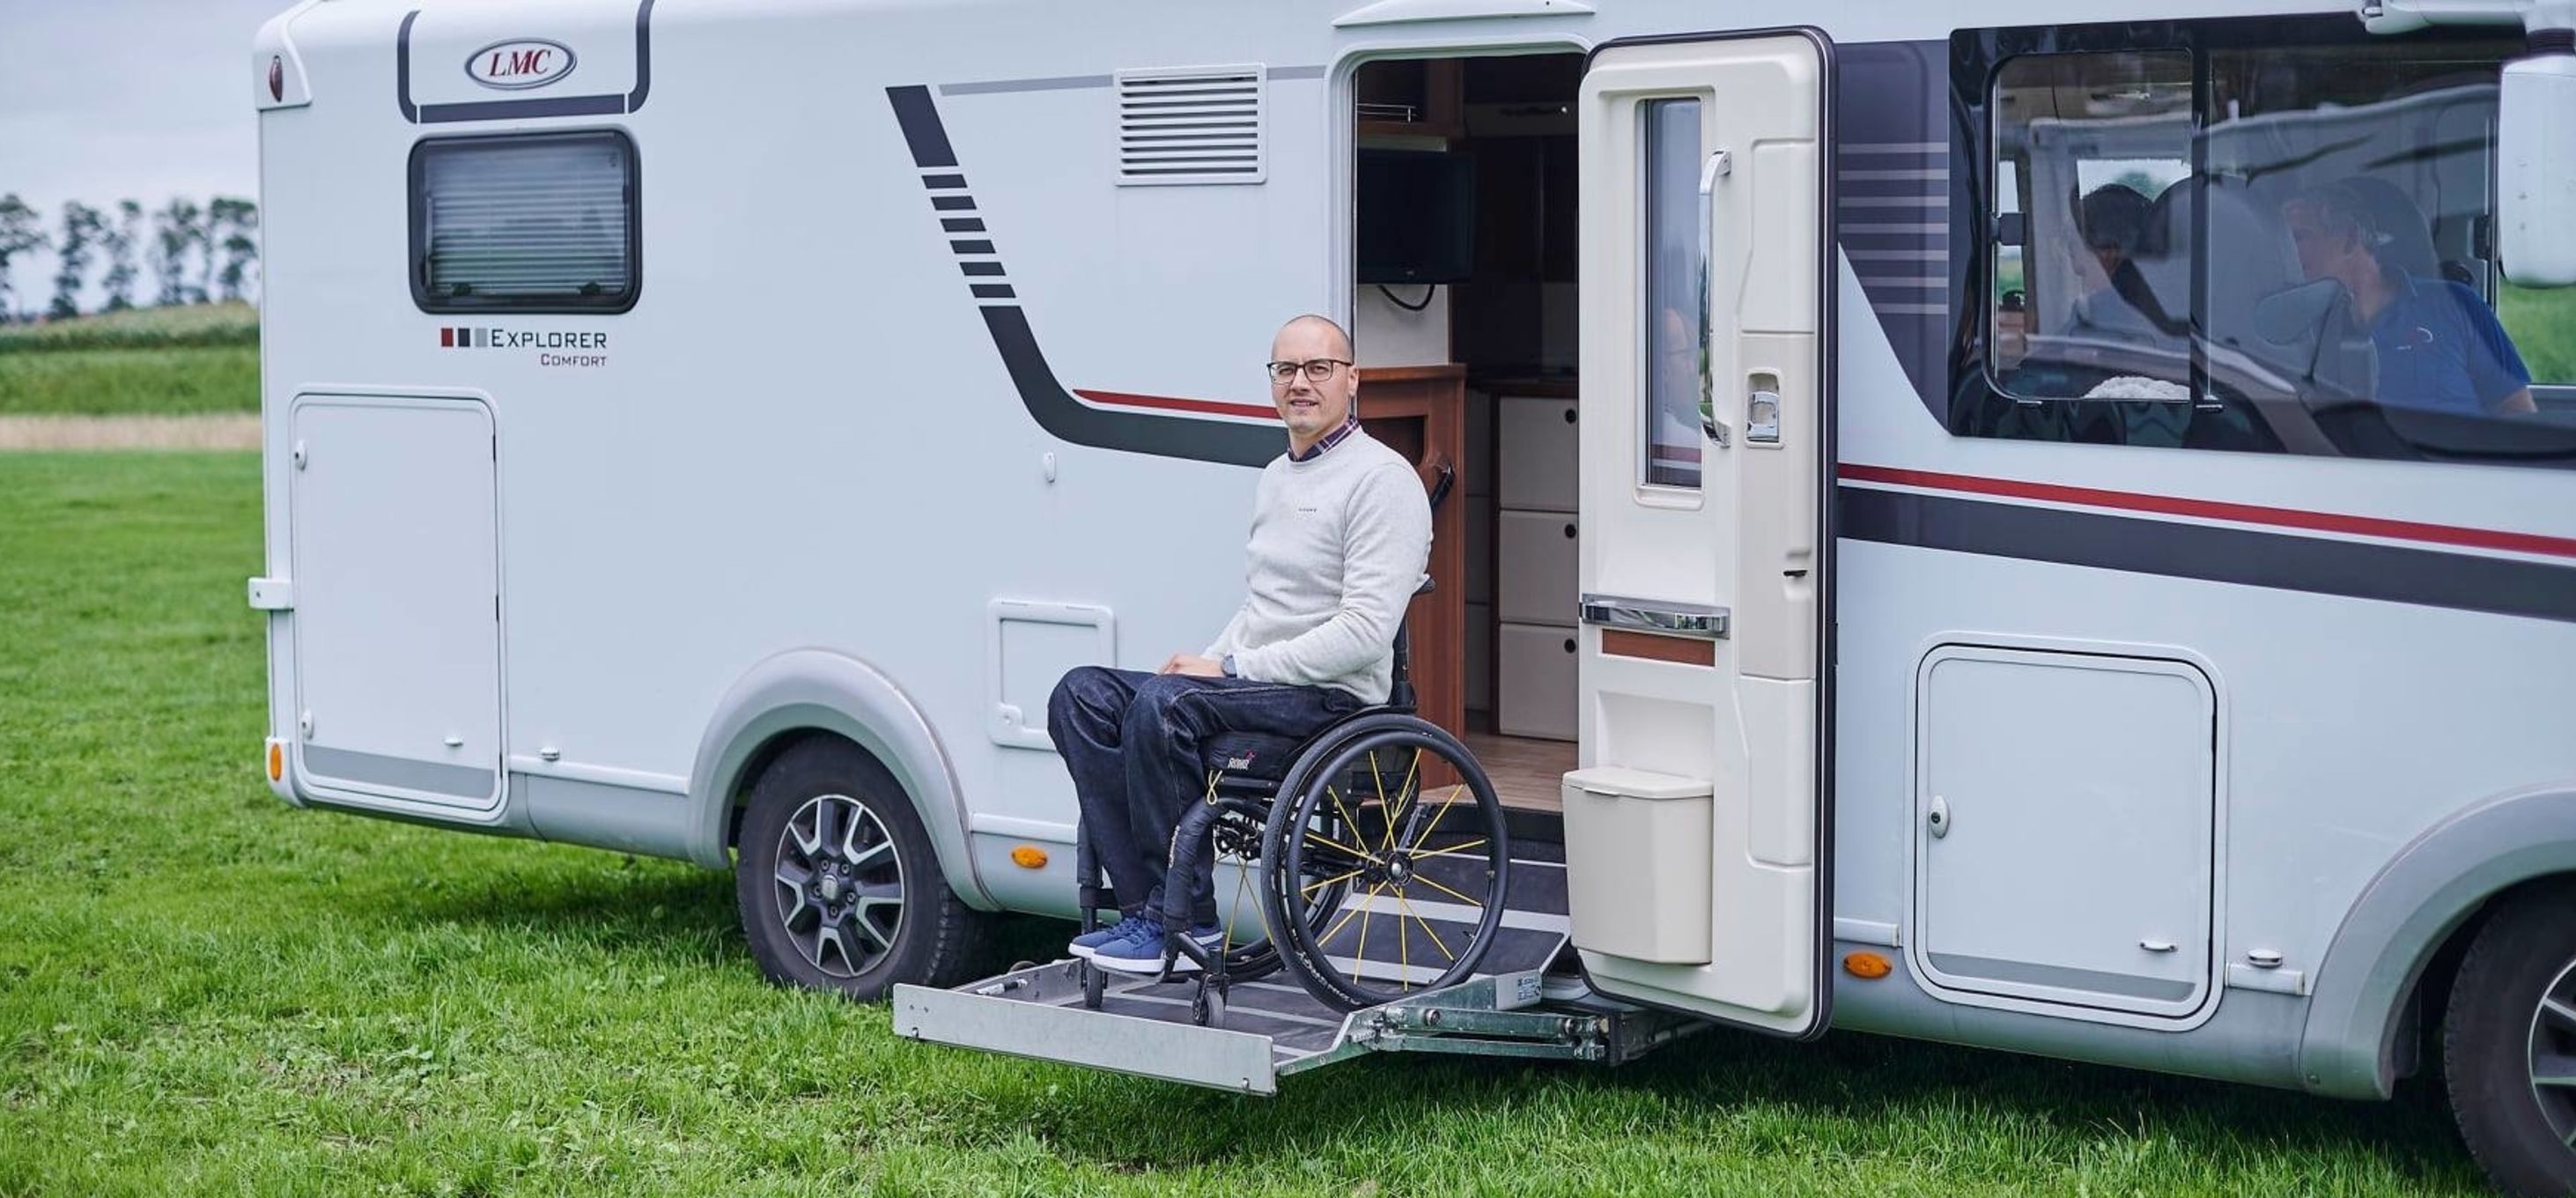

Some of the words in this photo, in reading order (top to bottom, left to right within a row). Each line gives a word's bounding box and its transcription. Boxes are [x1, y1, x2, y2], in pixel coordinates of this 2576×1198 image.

[489, 48, 551, 77] LMC
[491, 329, 607, 349] EXPLORER
[540, 353, 607, 366] COMFORT
